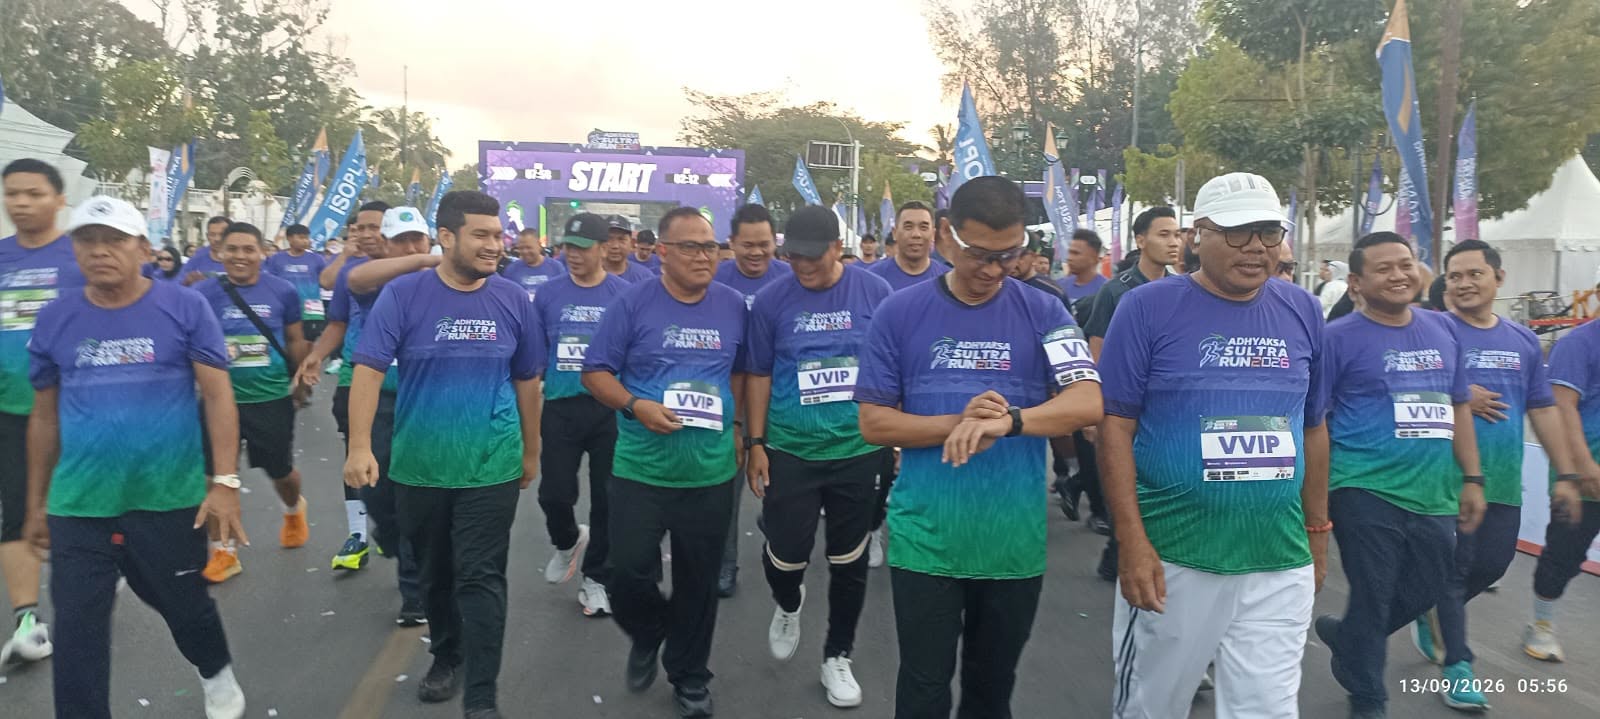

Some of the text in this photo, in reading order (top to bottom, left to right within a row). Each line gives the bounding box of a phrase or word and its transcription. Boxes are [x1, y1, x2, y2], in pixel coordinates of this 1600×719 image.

[568, 161, 657, 193] START
[678, 333, 720, 341] SULTRA
[1228, 337, 1287, 347] ADHYAKSA
[567, 346, 587, 356] VV
[956, 341, 1012, 350] ADHYAKSA
[952, 349, 1011, 359] SULTRA
[1224, 346, 1289, 357] SULTRA
[809, 370, 849, 385] VVIP
[676, 393, 714, 409] VVIP
[1407, 405, 1447, 420] VVIP
[1218, 435, 1280, 455] VVIP
